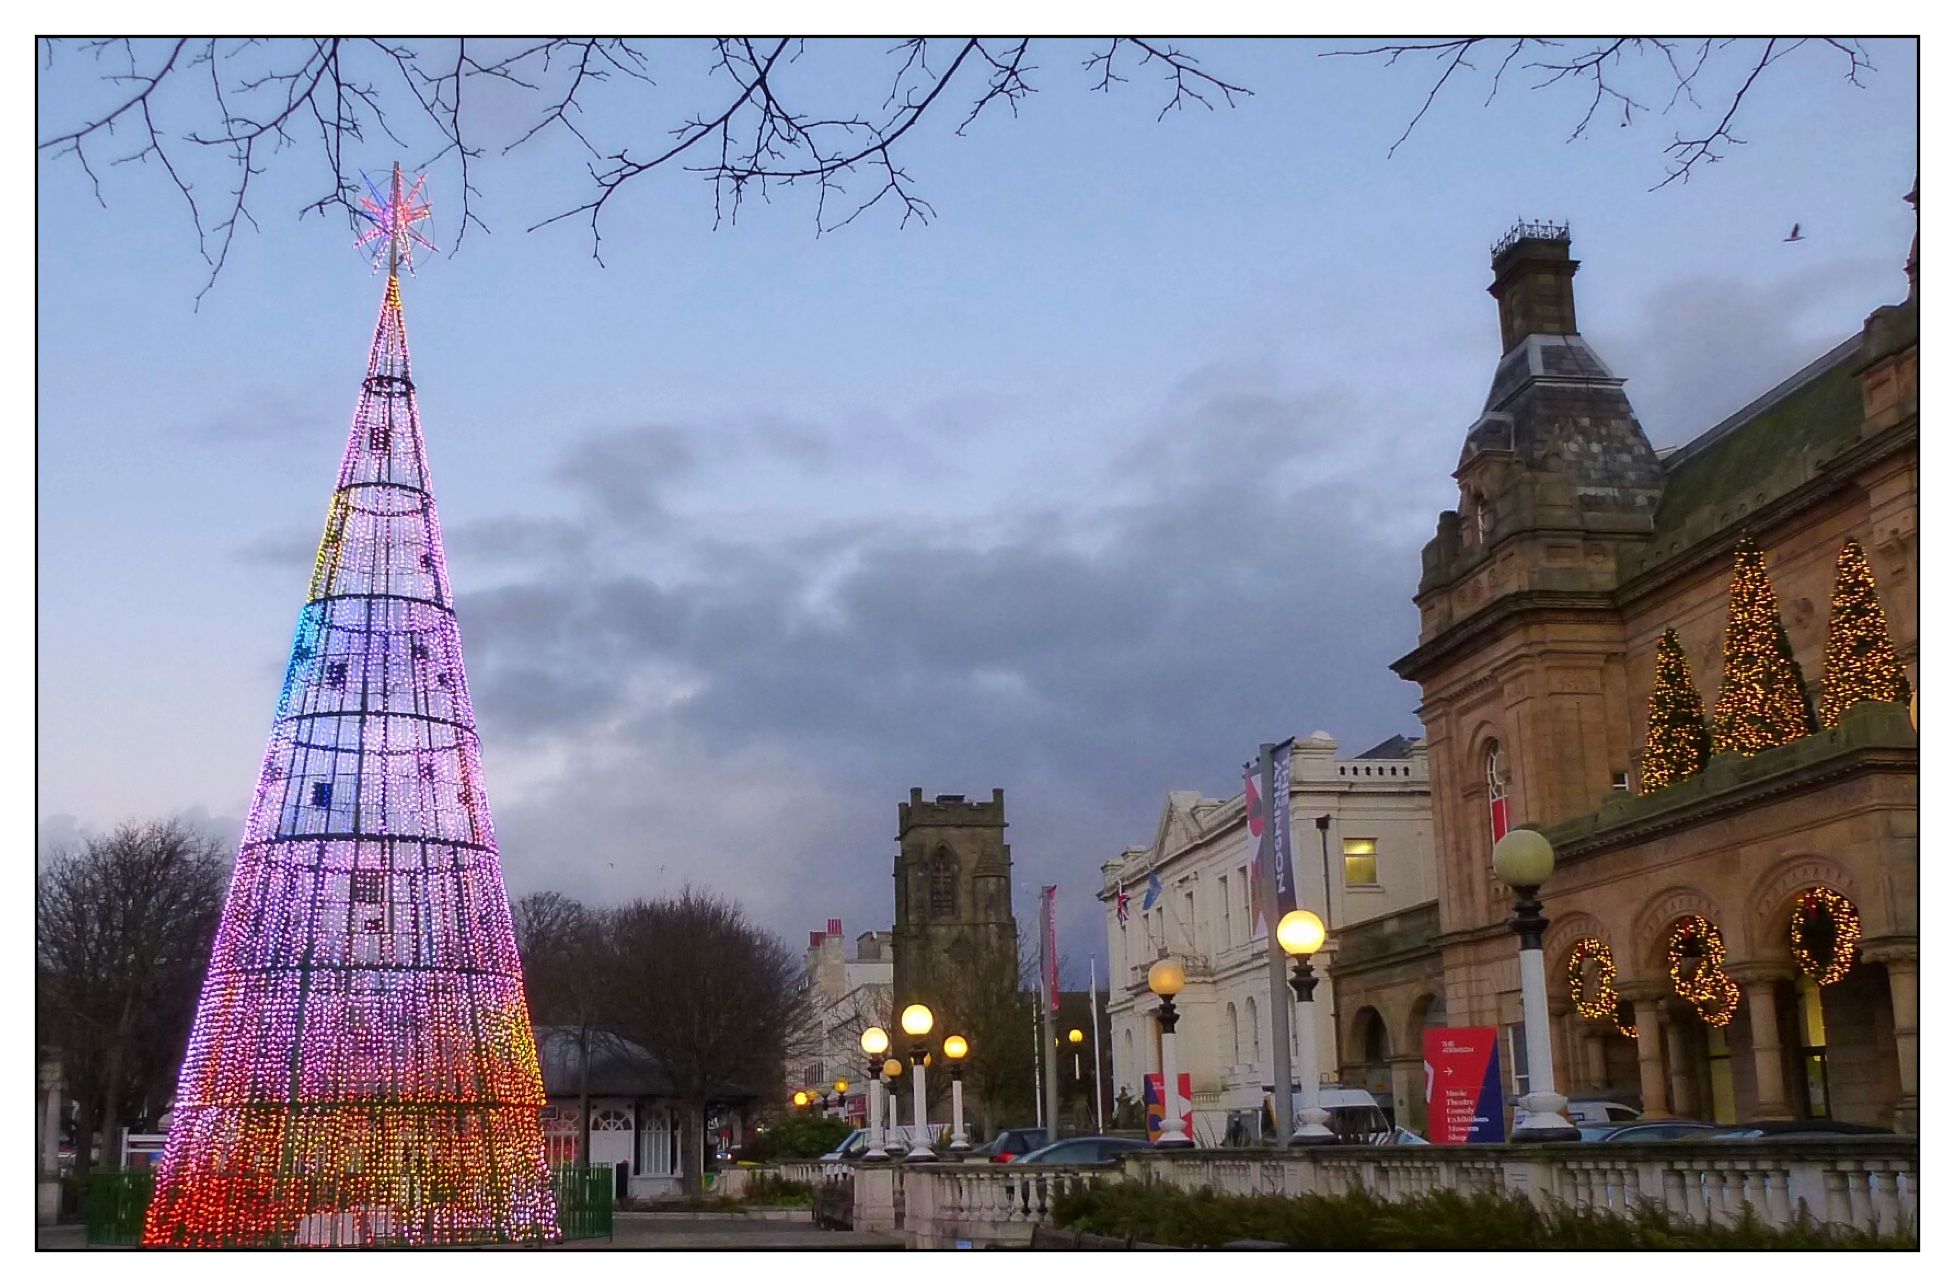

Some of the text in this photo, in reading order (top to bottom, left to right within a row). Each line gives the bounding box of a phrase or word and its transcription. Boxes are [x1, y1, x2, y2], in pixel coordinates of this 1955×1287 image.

[1282, 753, 1290, 805] THE
[1273, 760, 1286, 893] ATKINSON
[1446, 1107, 1474, 1115] Comedy
[1448, 1134, 1467, 1142] Shop
